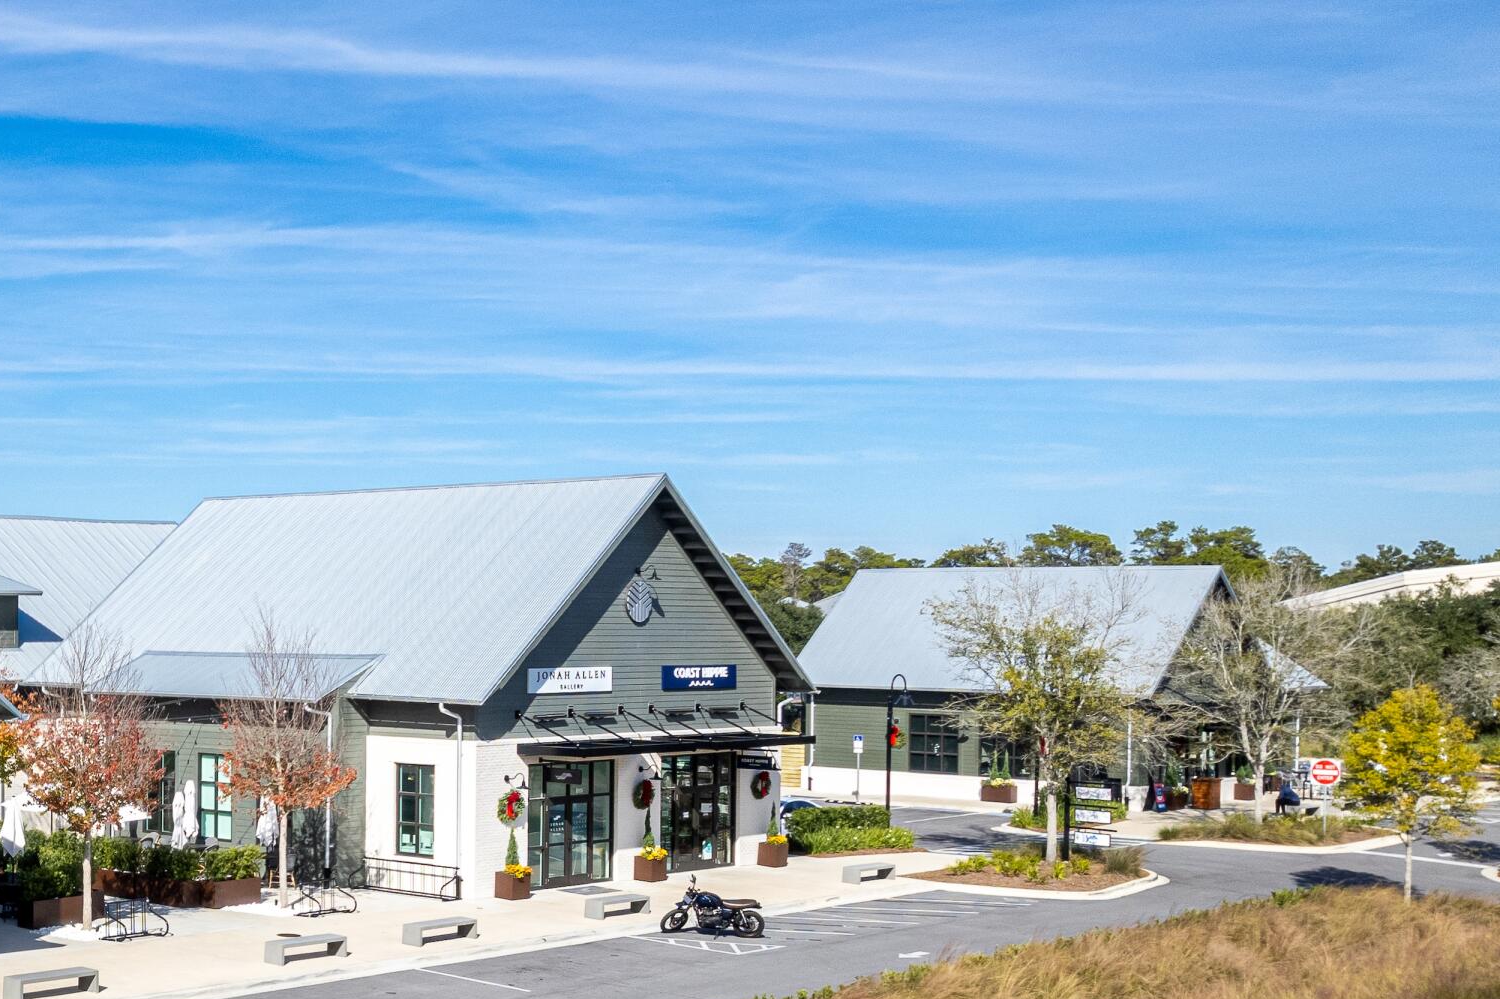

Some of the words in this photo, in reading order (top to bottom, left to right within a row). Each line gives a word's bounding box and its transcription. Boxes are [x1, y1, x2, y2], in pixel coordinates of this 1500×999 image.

[536, 671, 570, 683] JONAH
[575, 669, 606, 680] ALLEN
[673, 667, 700, 679] COAST
[701, 666, 729, 678] HIPPIE
